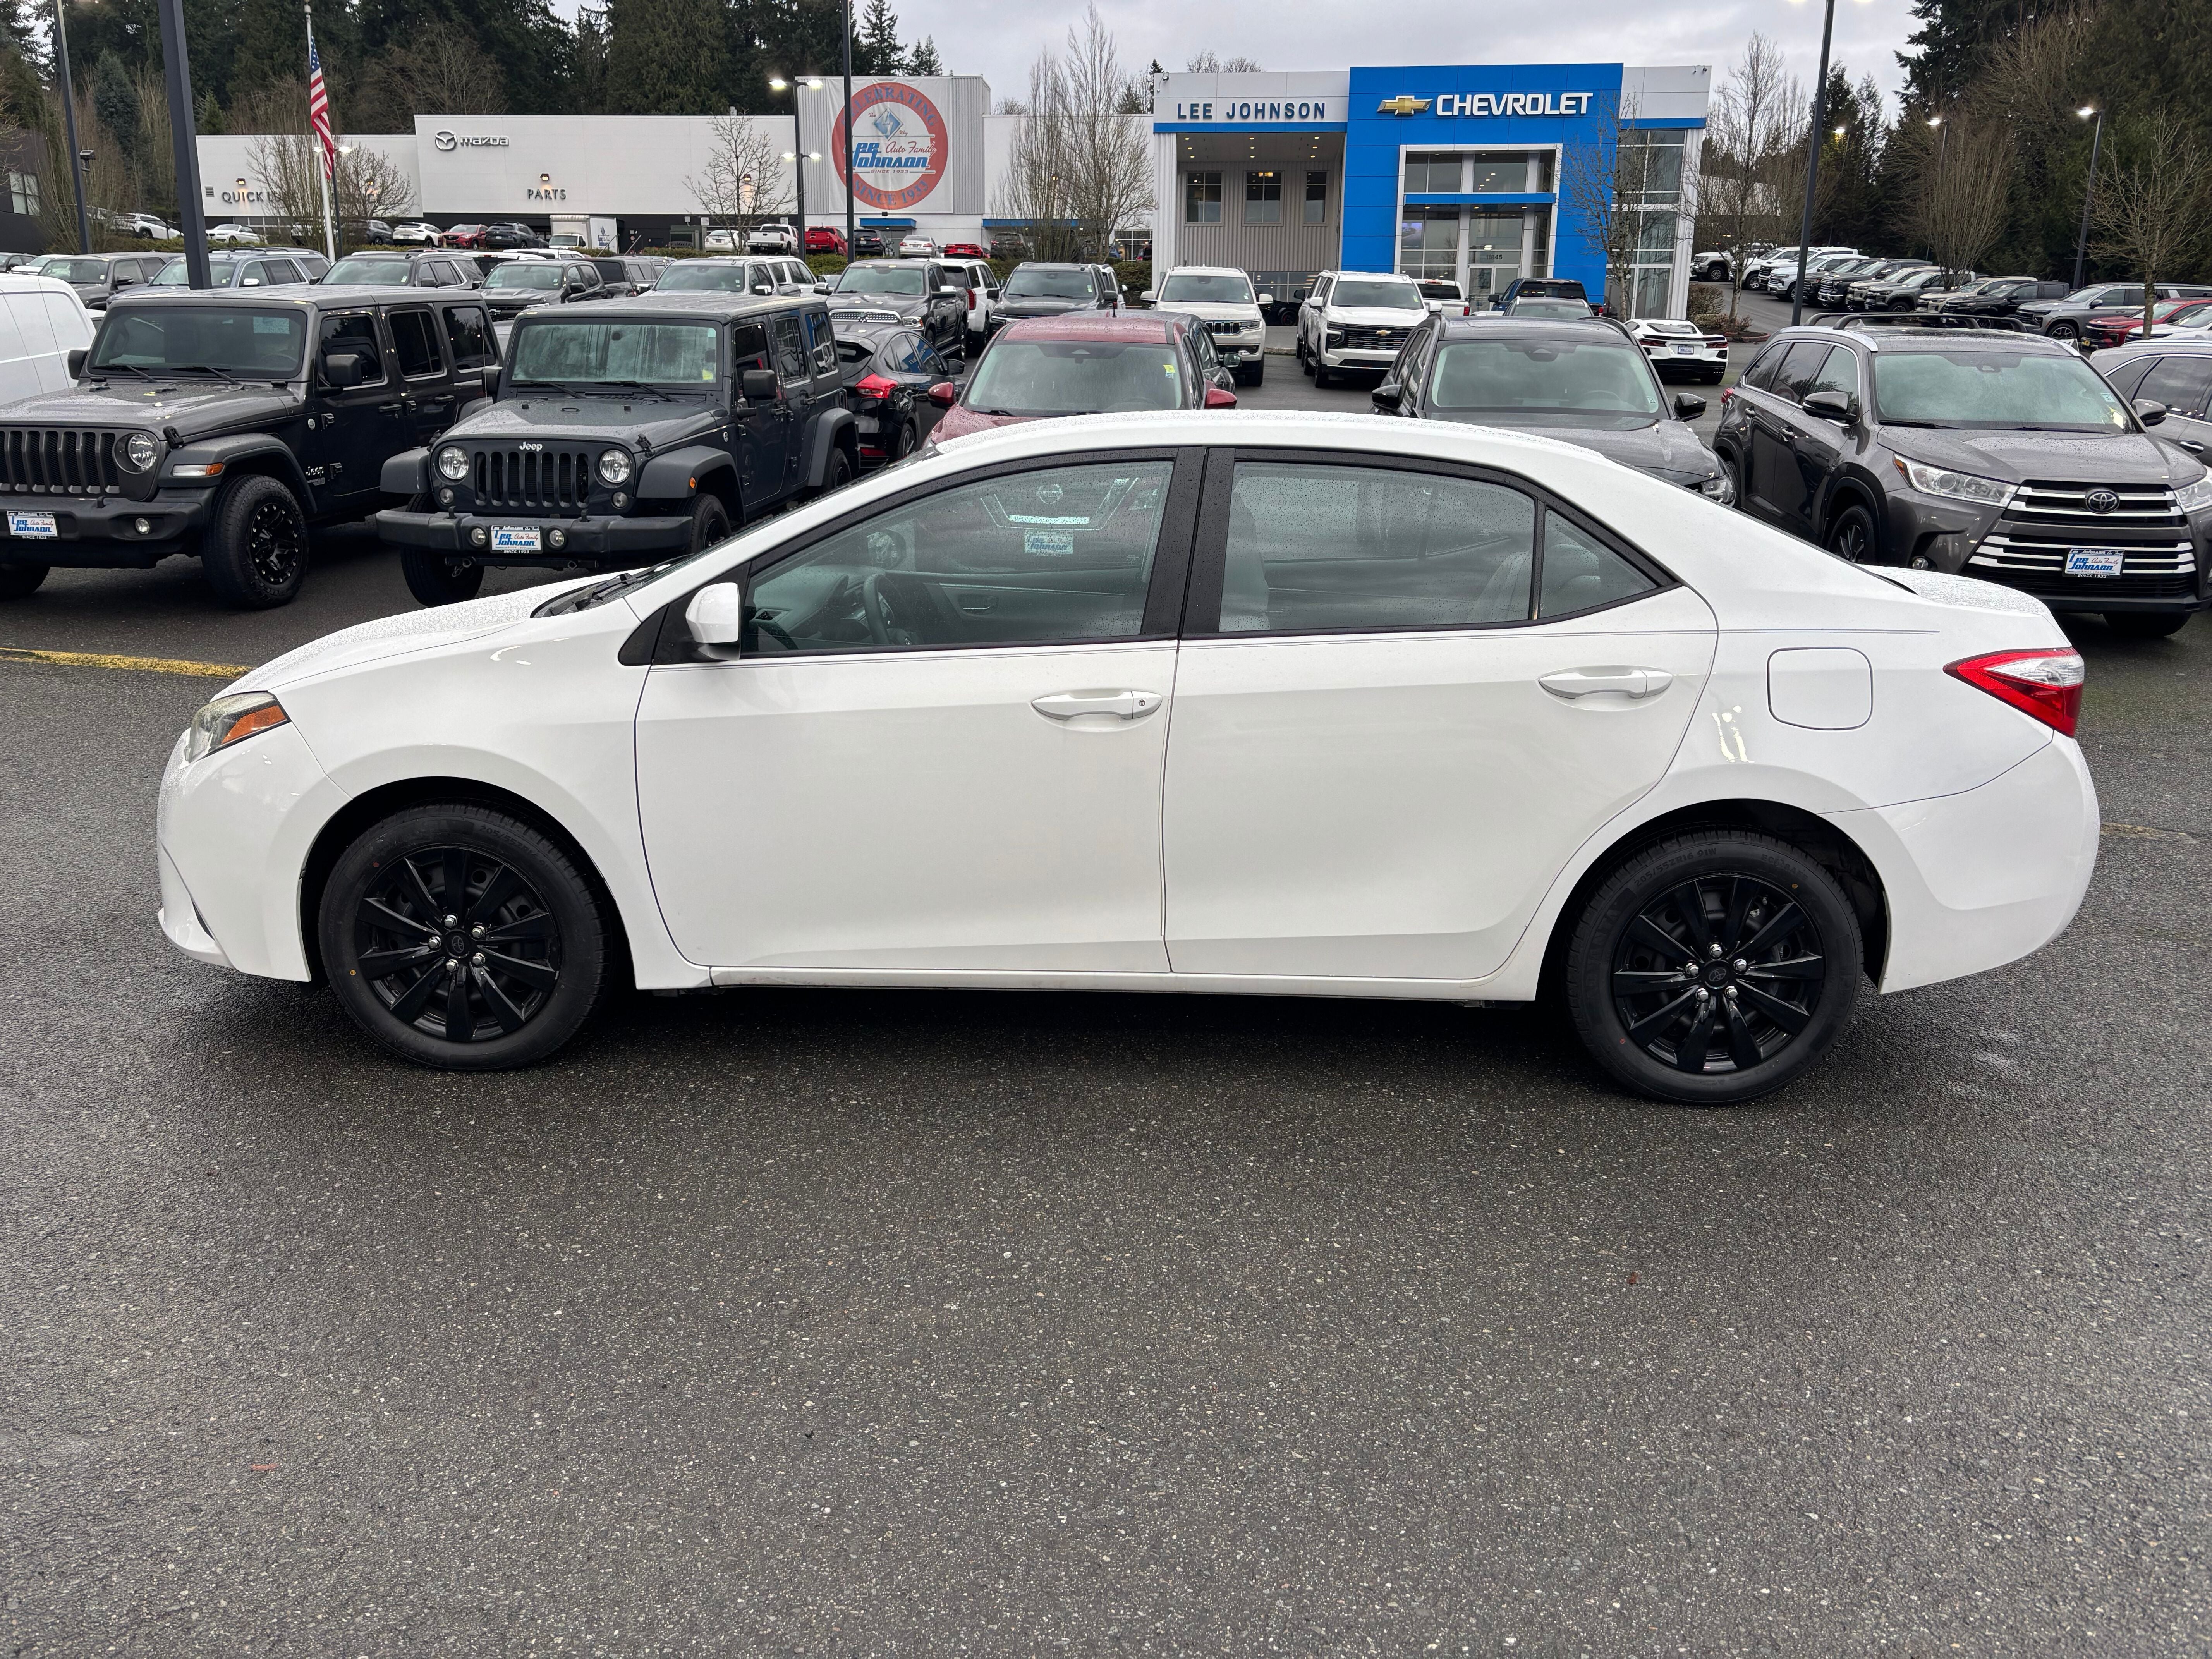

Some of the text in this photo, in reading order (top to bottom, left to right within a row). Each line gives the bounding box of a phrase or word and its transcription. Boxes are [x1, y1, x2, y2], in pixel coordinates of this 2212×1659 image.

[1437, 93, 1593, 115] CHEVROLET
[1178, 102, 1325, 119] LEE JOHNSON
[460, 136, 509, 146] mazda
[844, 141, 937, 158] ee Auto Family
[222, 191, 264, 204] QUICK
[527, 189, 566, 200] PARTS
[855, 180, 928, 206] SINCE 1933
[519, 441, 543, 452] Jeep
[12, 515, 29, 525] Lee
[495, 530, 513, 539] Lee
[2069, 554, 2089, 563] Lee
[2103, 558, 2119, 566] Family
[2068, 563, 2114, 571] Johnson
[1634, 848, 1717, 887] 205/55ZR16 91W
